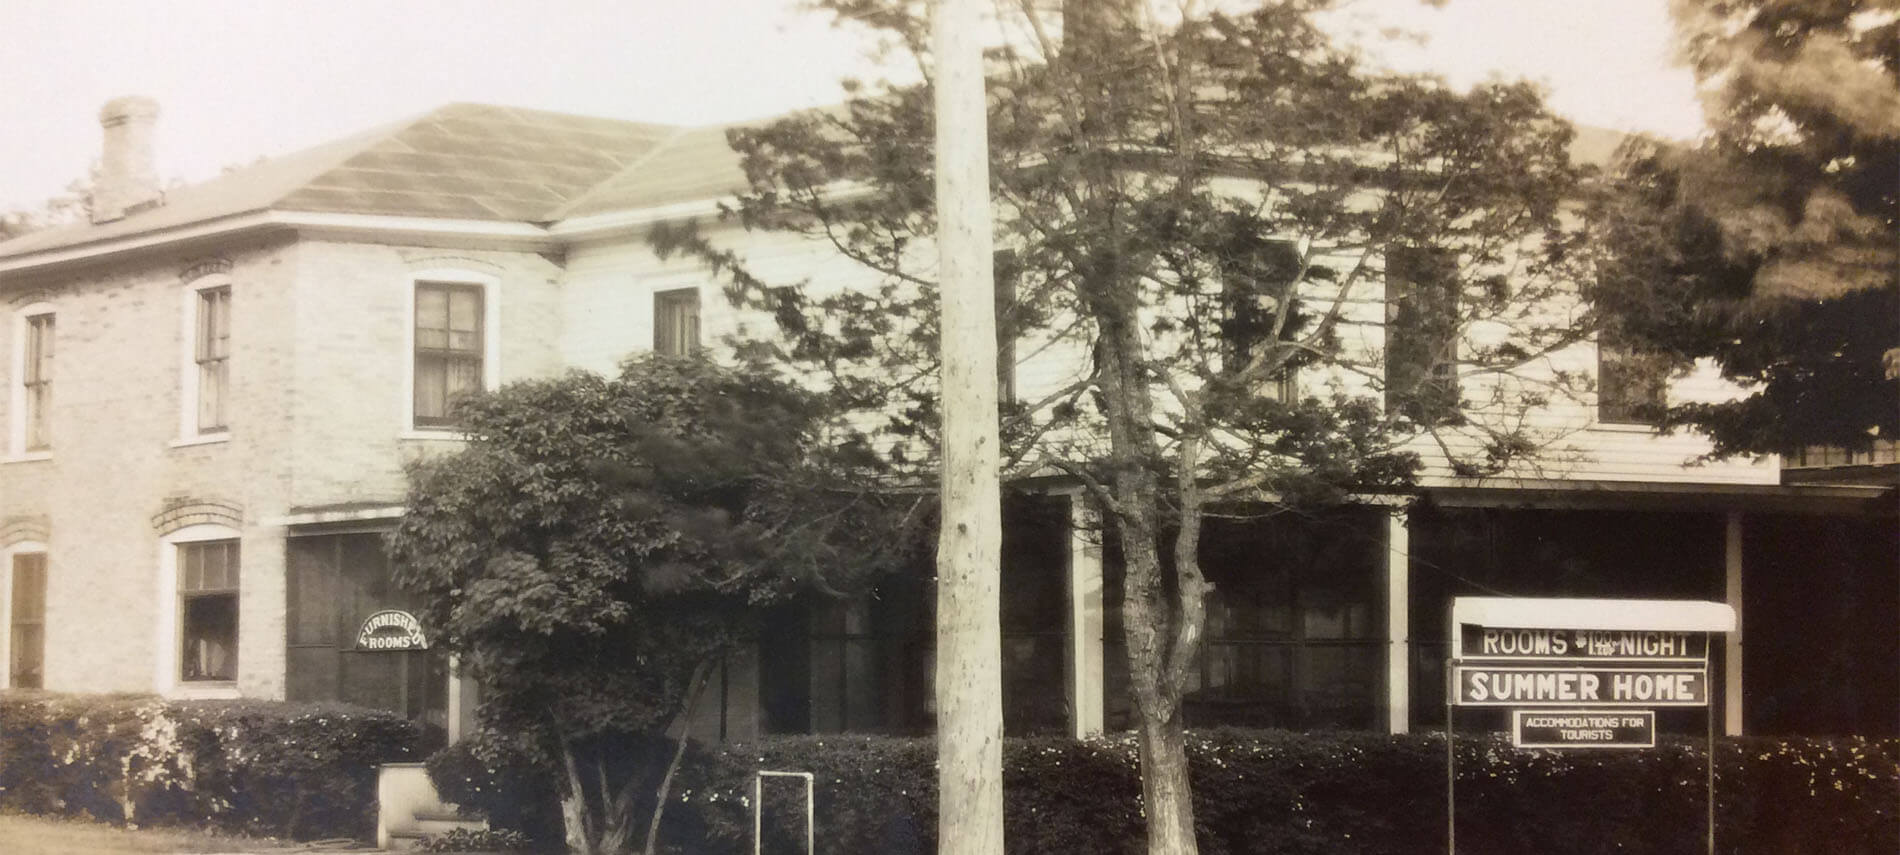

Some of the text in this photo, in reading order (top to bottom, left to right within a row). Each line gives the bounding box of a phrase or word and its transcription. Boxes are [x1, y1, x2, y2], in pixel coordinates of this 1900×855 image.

[359, 613, 422, 647] FURNISHED
[368, 636, 411, 649] ROOMS
[1483, 631, 1568, 655] ROOMS
[1620, 631, 1688, 656] NIGHT
[1470, 672, 1695, 701] SUMMER HOME
[1525, 717, 1645, 728] ACCOMMODATIONS FOR
[1560, 729, 1614, 741] TOURISTS
